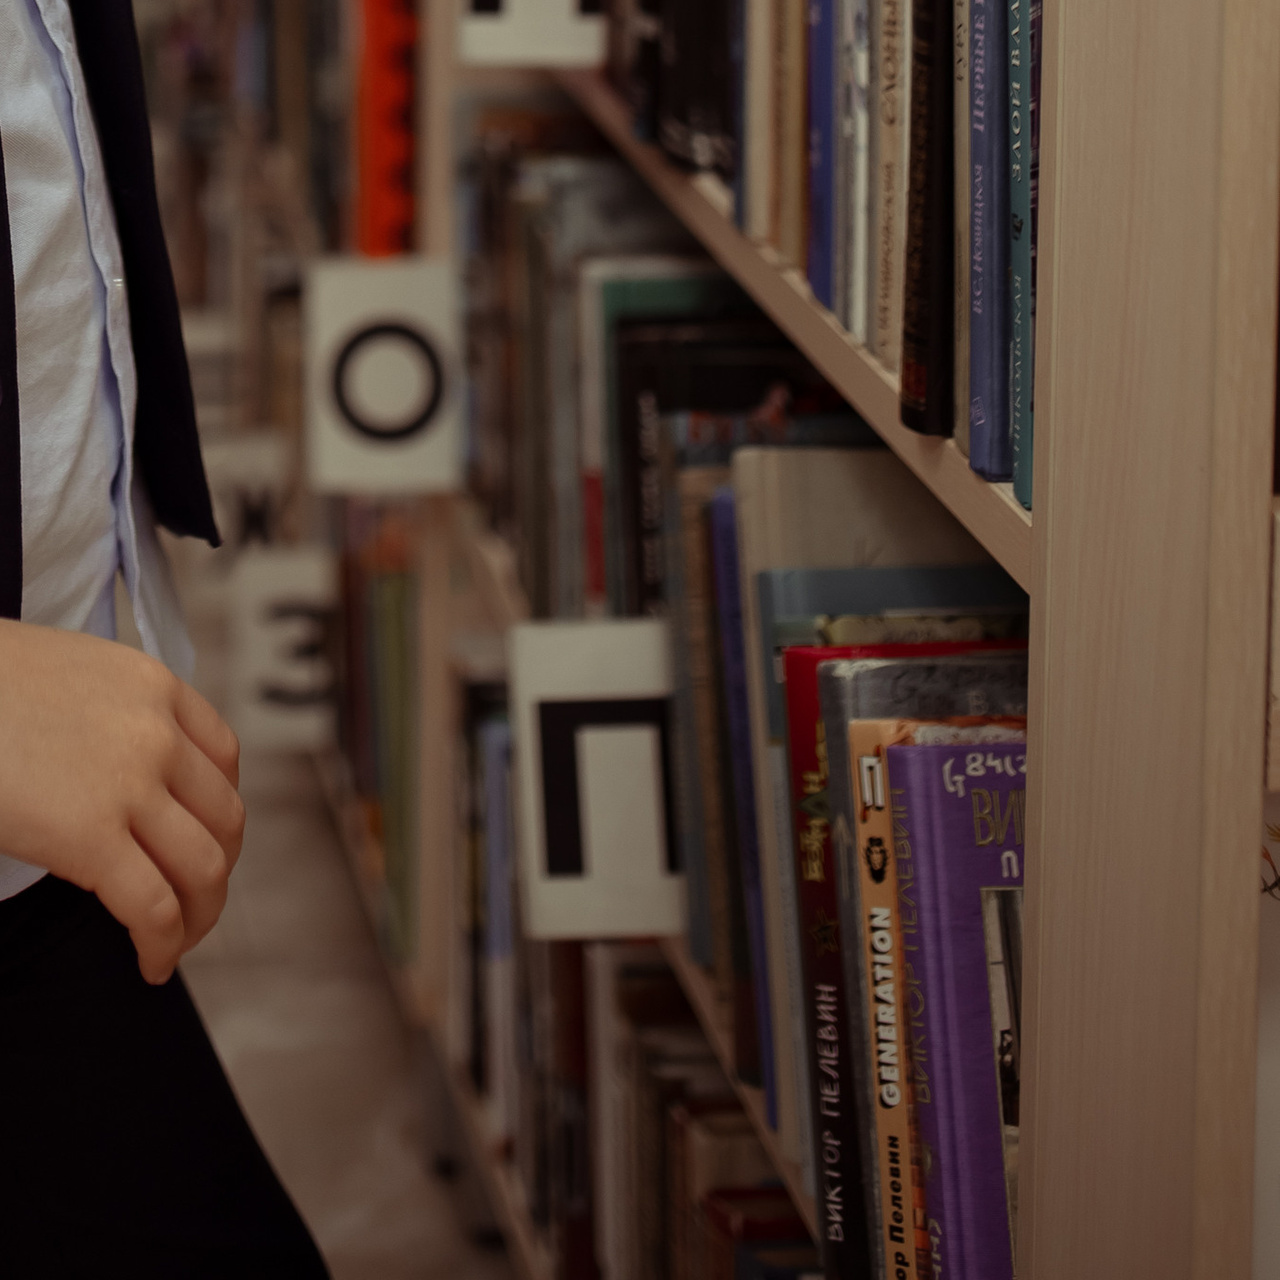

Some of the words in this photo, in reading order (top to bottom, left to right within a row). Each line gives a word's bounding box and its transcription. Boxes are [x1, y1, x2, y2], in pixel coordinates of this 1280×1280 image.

[1010, 80, 1023, 184] ЗЛОЙ
[537, 696, 681, 878] П
[815, 982, 841, 1118] ПЕЛЕВИН
[868, 906, 901, 1108] GENERATION
[821, 1131, 846, 1242] ВИКТОР
[887, 1135, 906, 1244] Пелевин
